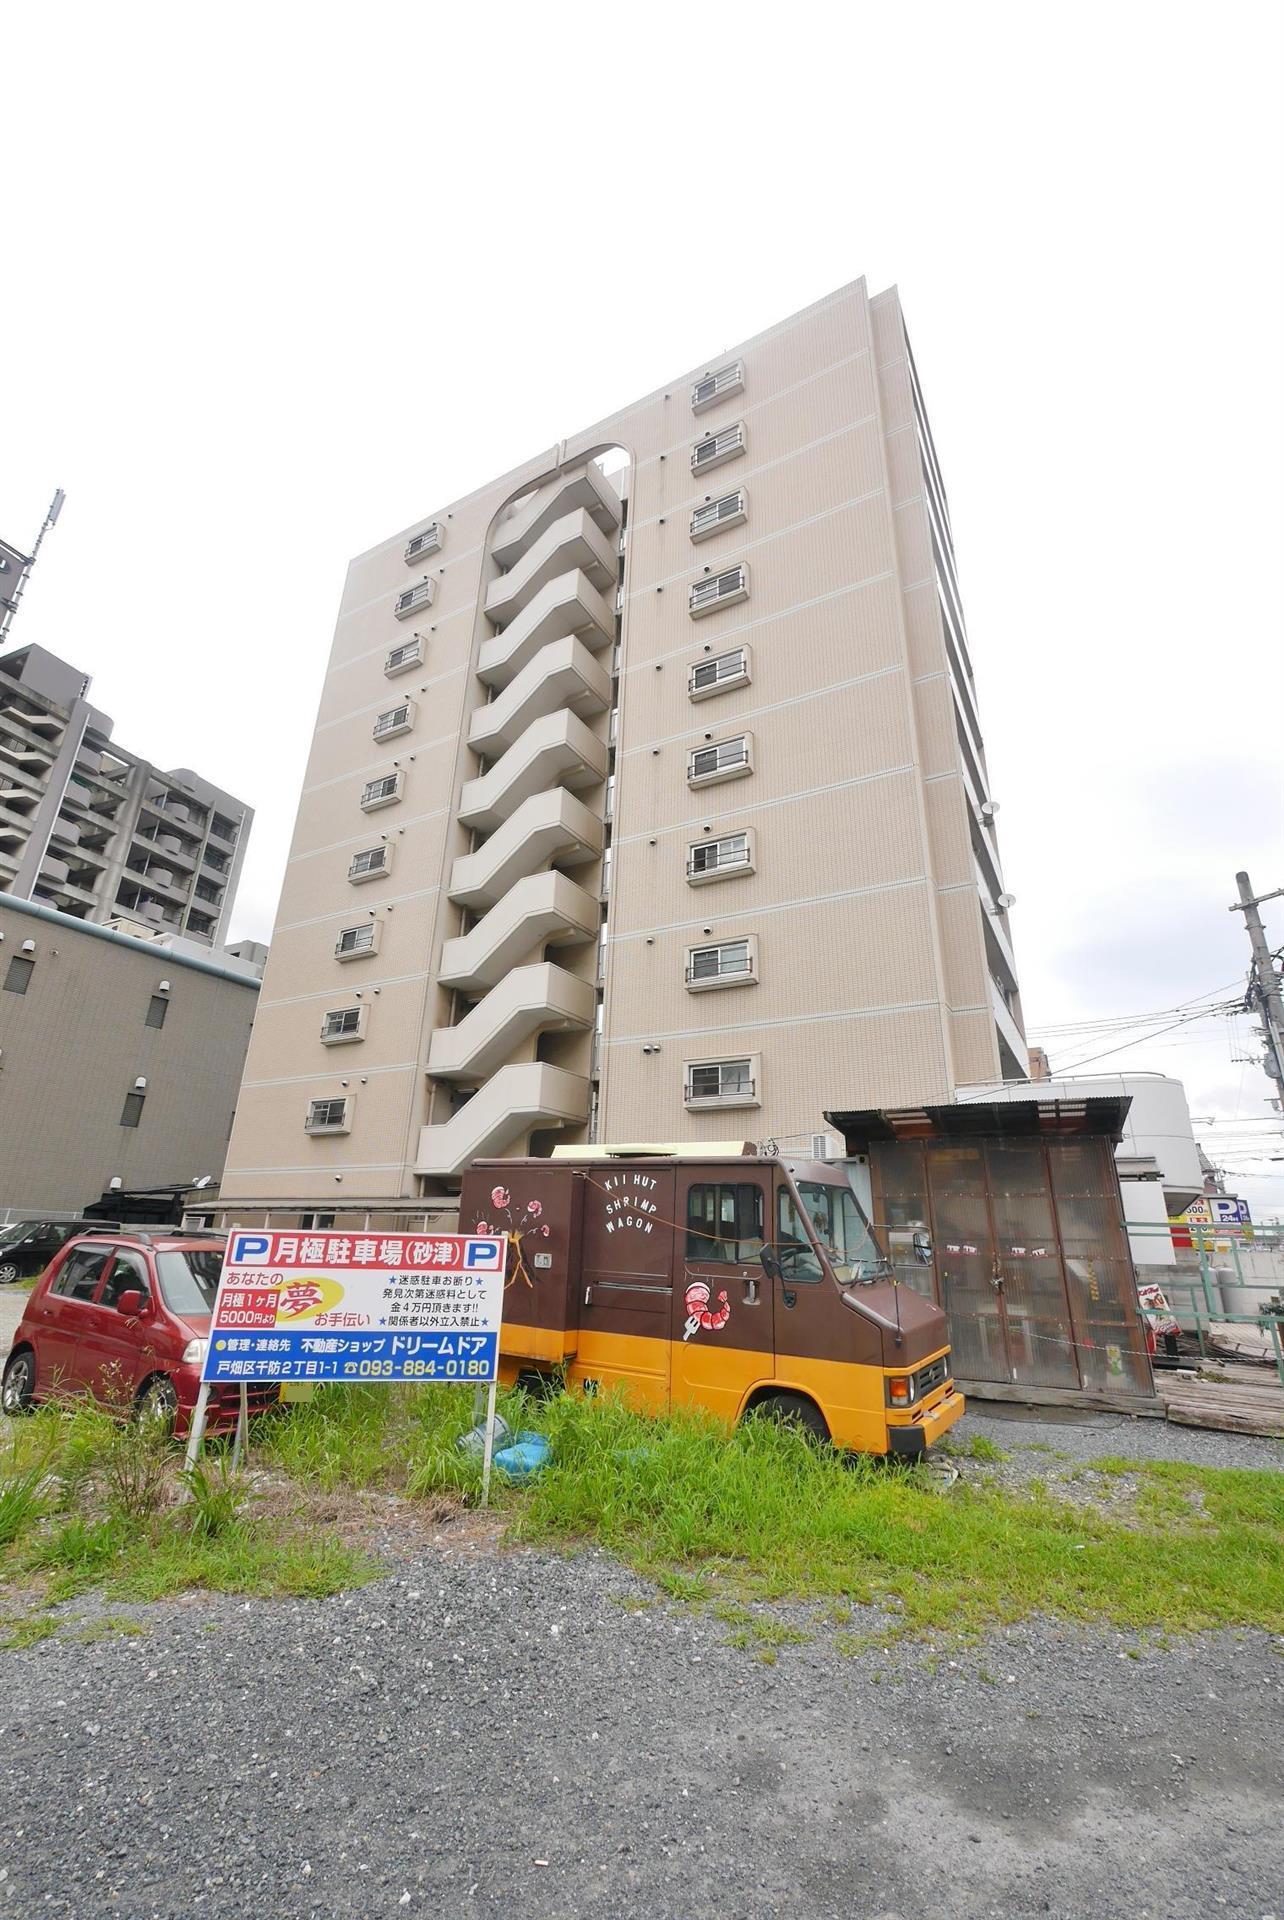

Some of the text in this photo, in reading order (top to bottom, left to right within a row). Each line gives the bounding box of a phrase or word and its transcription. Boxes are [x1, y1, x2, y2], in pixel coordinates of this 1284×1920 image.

[604, 1173, 657, 1191] KII HUT
[605, 1196, 657, 1215] SHRIMP
[605, 1215, 653, 1234] WAGON
[235, 1237, 498, 1266] P 月極駐車場(砂津) P
[226, 1271, 284, 1286] あなたの
[280, 1281, 323, 1319] 夢
[382, 1288, 488, 1300] 発見次第迷惑料として
[219, 1310, 276, 1324] 5000円より
[314, 1311, 371, 1327] お手伝い
[388, 1315, 480, 1327] 関係者以外立入禁止
[300, 1337, 386, 1353] 不動産ショップ
[391, 1335, 488, 1355] ドリームドア
[359, 1360, 490, 1376] 093-884-0180
